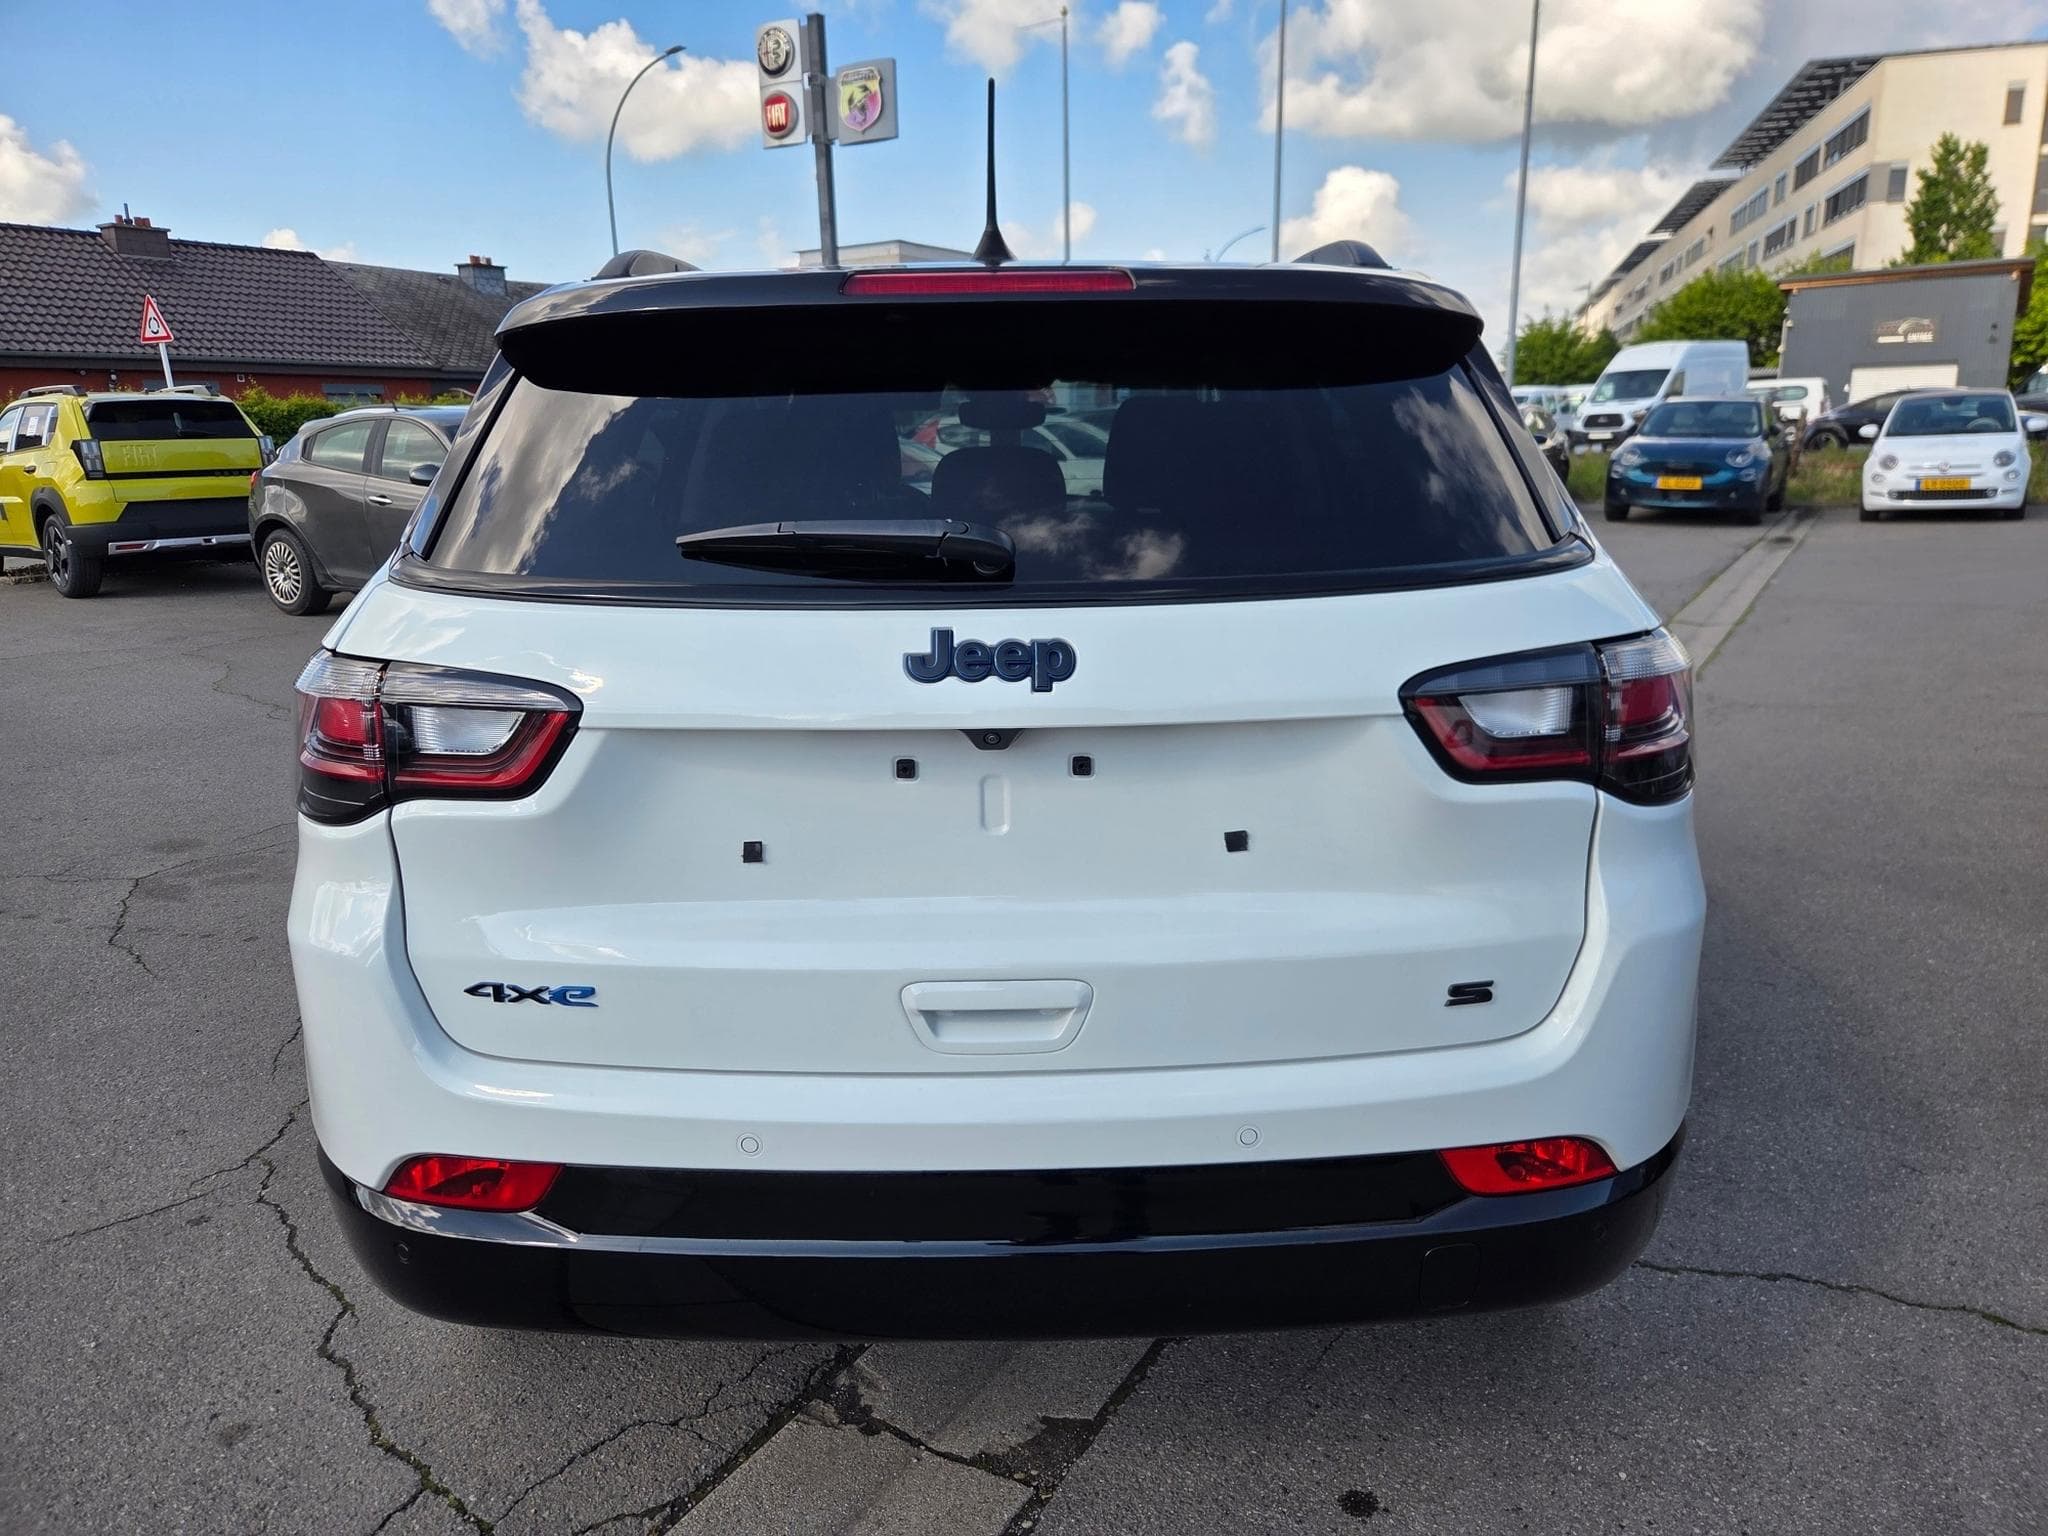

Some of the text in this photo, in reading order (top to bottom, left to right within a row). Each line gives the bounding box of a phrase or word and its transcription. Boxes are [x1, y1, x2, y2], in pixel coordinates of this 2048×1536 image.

[766, 102, 788, 129] FIAT
[120, 444, 159, 467] FIAT
[904, 627, 1077, 692] Jeep
[1443, 979, 1495, 1008] S
